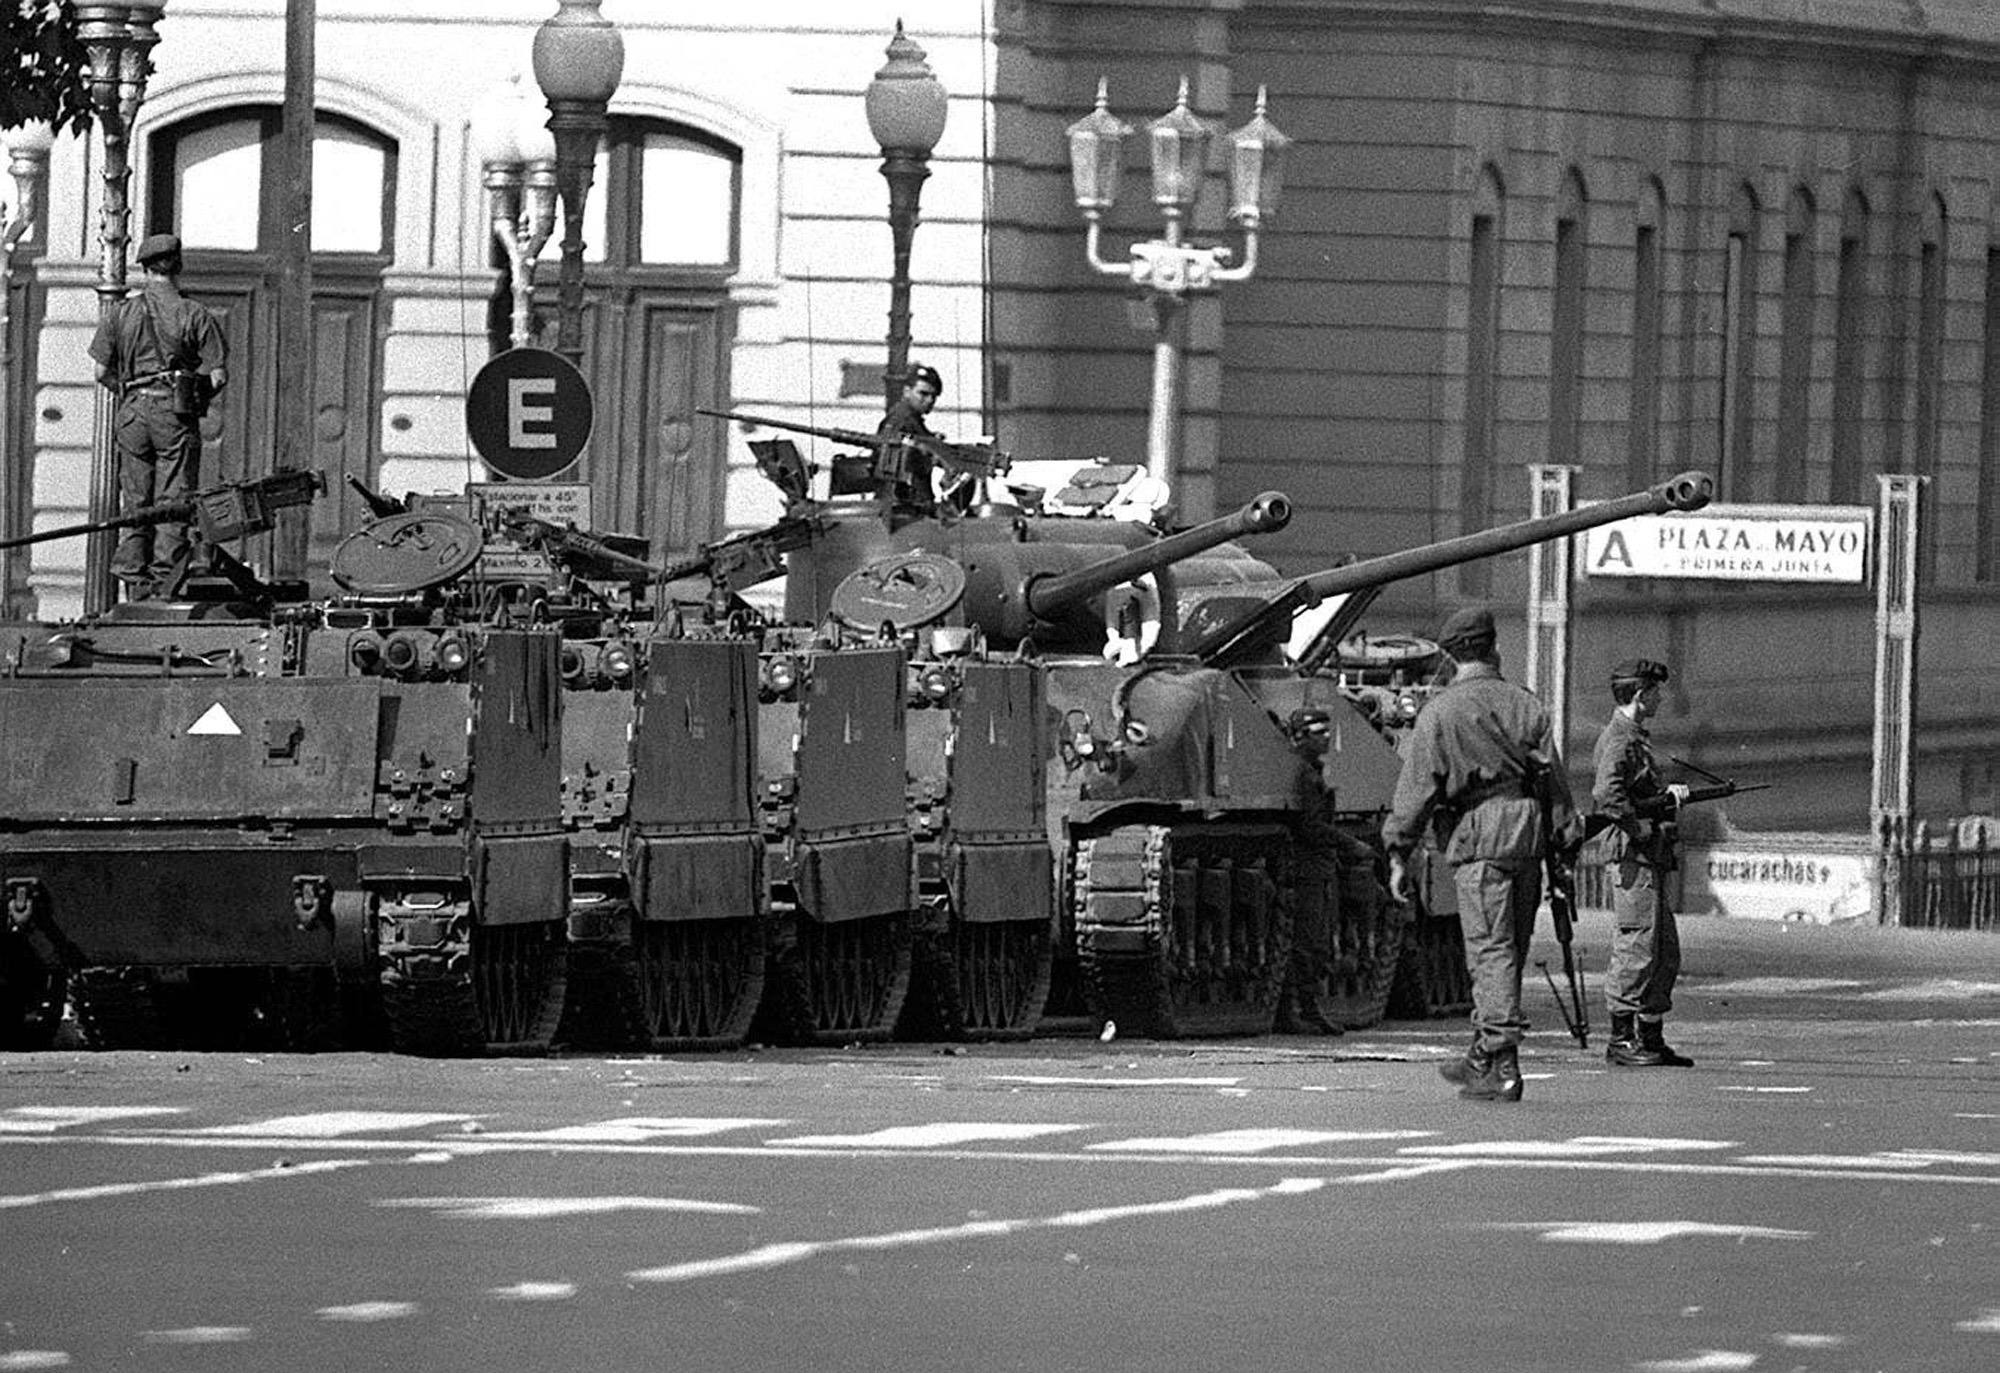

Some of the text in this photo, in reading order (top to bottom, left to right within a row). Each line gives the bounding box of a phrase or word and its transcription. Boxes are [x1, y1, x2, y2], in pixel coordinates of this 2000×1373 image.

[508, 378, 556, 448] E
[482, 491, 539, 501] stacionar
[1597, 529, 1633, 568] A
[1659, 527, 1858, 553] PLAZA MAYO
